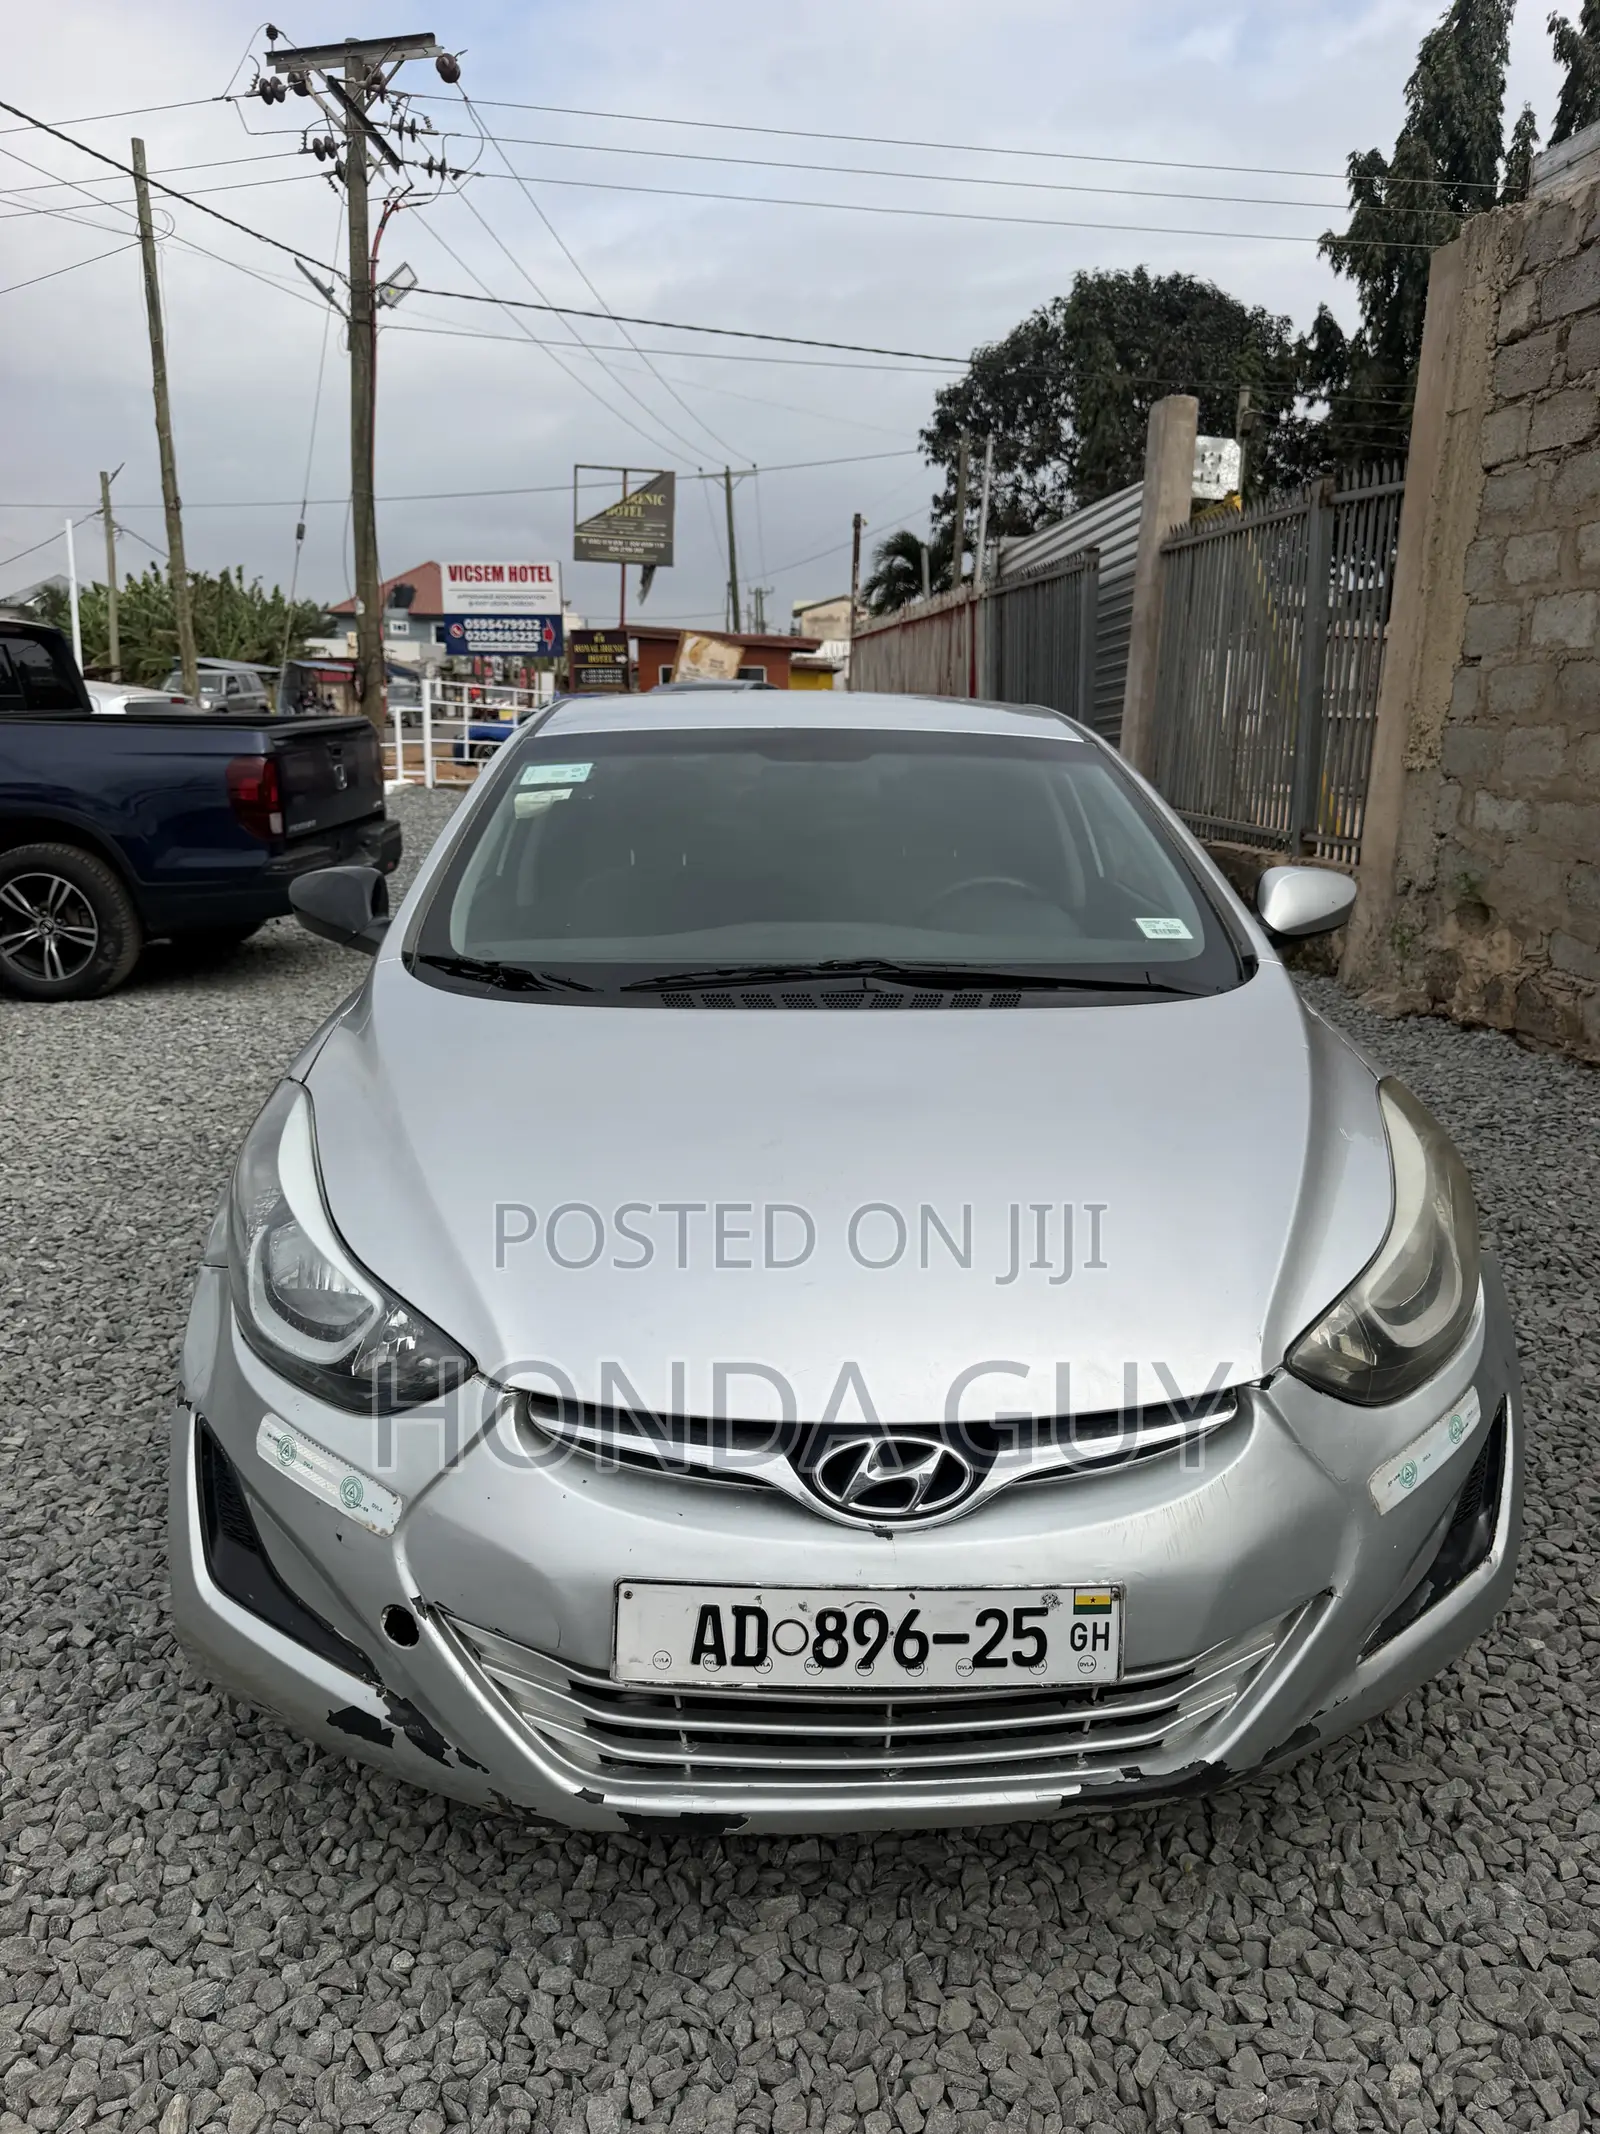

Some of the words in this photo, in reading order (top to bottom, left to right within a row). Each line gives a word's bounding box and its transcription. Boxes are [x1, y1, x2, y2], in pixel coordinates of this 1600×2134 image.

[448, 565, 505, 582] VICSEM
[508, 565, 553, 583] HOTEL
[690, 1603, 769, 1667] AD
[812, 1606, 1049, 1668] 896-25
[1069, 1621, 1110, 1652] GH
